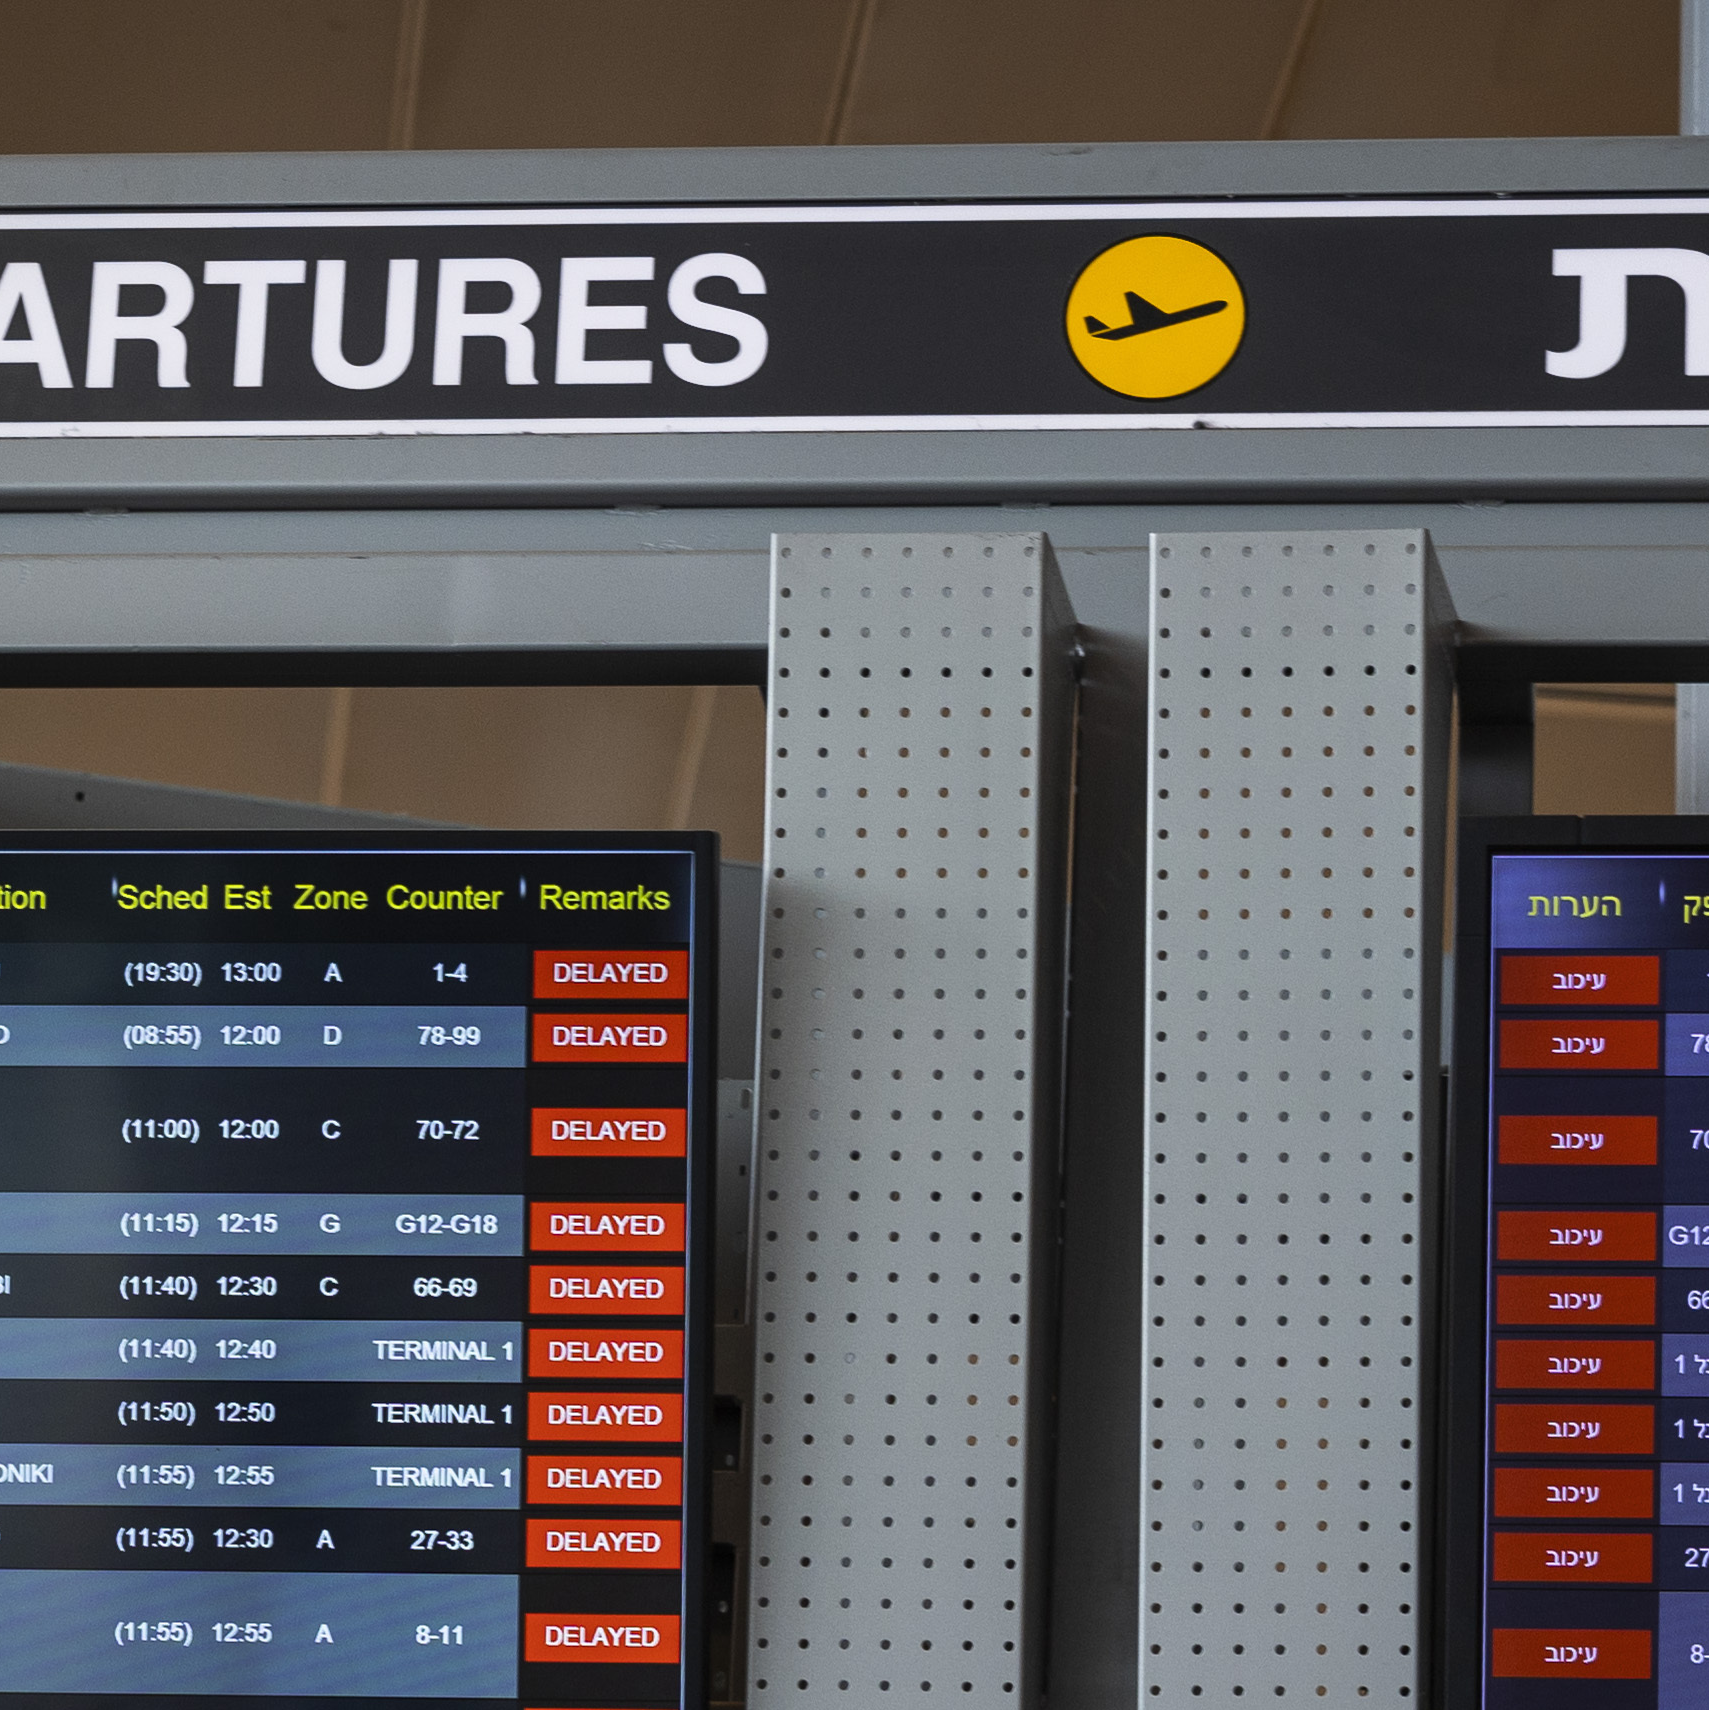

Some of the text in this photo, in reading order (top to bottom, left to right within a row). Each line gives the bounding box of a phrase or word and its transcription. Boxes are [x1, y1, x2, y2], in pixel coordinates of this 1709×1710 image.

[117, 883, 208, 910] Sched
[223, 883, 273, 910] Est
[292, 883, 369, 911] Zone
[385, 883, 505, 911] Counter
[539, 883, 672, 911] Remarks
[1527, 895, 1622, 919] הערות
[123, 961, 203, 988] (19:30)
[220, 961, 283, 983] 13:00
[323, 961, 344, 983] A
[432, 962, 469, 983] 1-4
[553, 962, 669, 985] DELAYED
[1551, 972, 1607, 991] עיכוב
[123, 1024, 202, 1051] (08:55)
[219, 1025, 282, 1046] 12:00
[322, 1025, 343, 1046] D
[417, 1025, 482, 1046] 78-99
[552, 1025, 668, 1047] DELAYED
[119, 1212, 200, 1238] (11:15)
[216, 1212, 279, 1234] 12:15
[319, 1213, 341, 1234] G
[394, 1213, 499, 1235] G12-G18
[549, 1213, 666, 1236] DELAYED
[1548, 1292, 1603, 1311] עיכוב
[116, 1464, 196, 1490] (11:55)
[213, 1464, 275, 1486] 12:55
[370, 1466, 512, 1489] TERMINAL 1
[546, 1467, 663, 1490] DELAYED
[1545, 1485, 1601, 1504] עיכוב
[1672, 1482, 1684, 1503] 1
